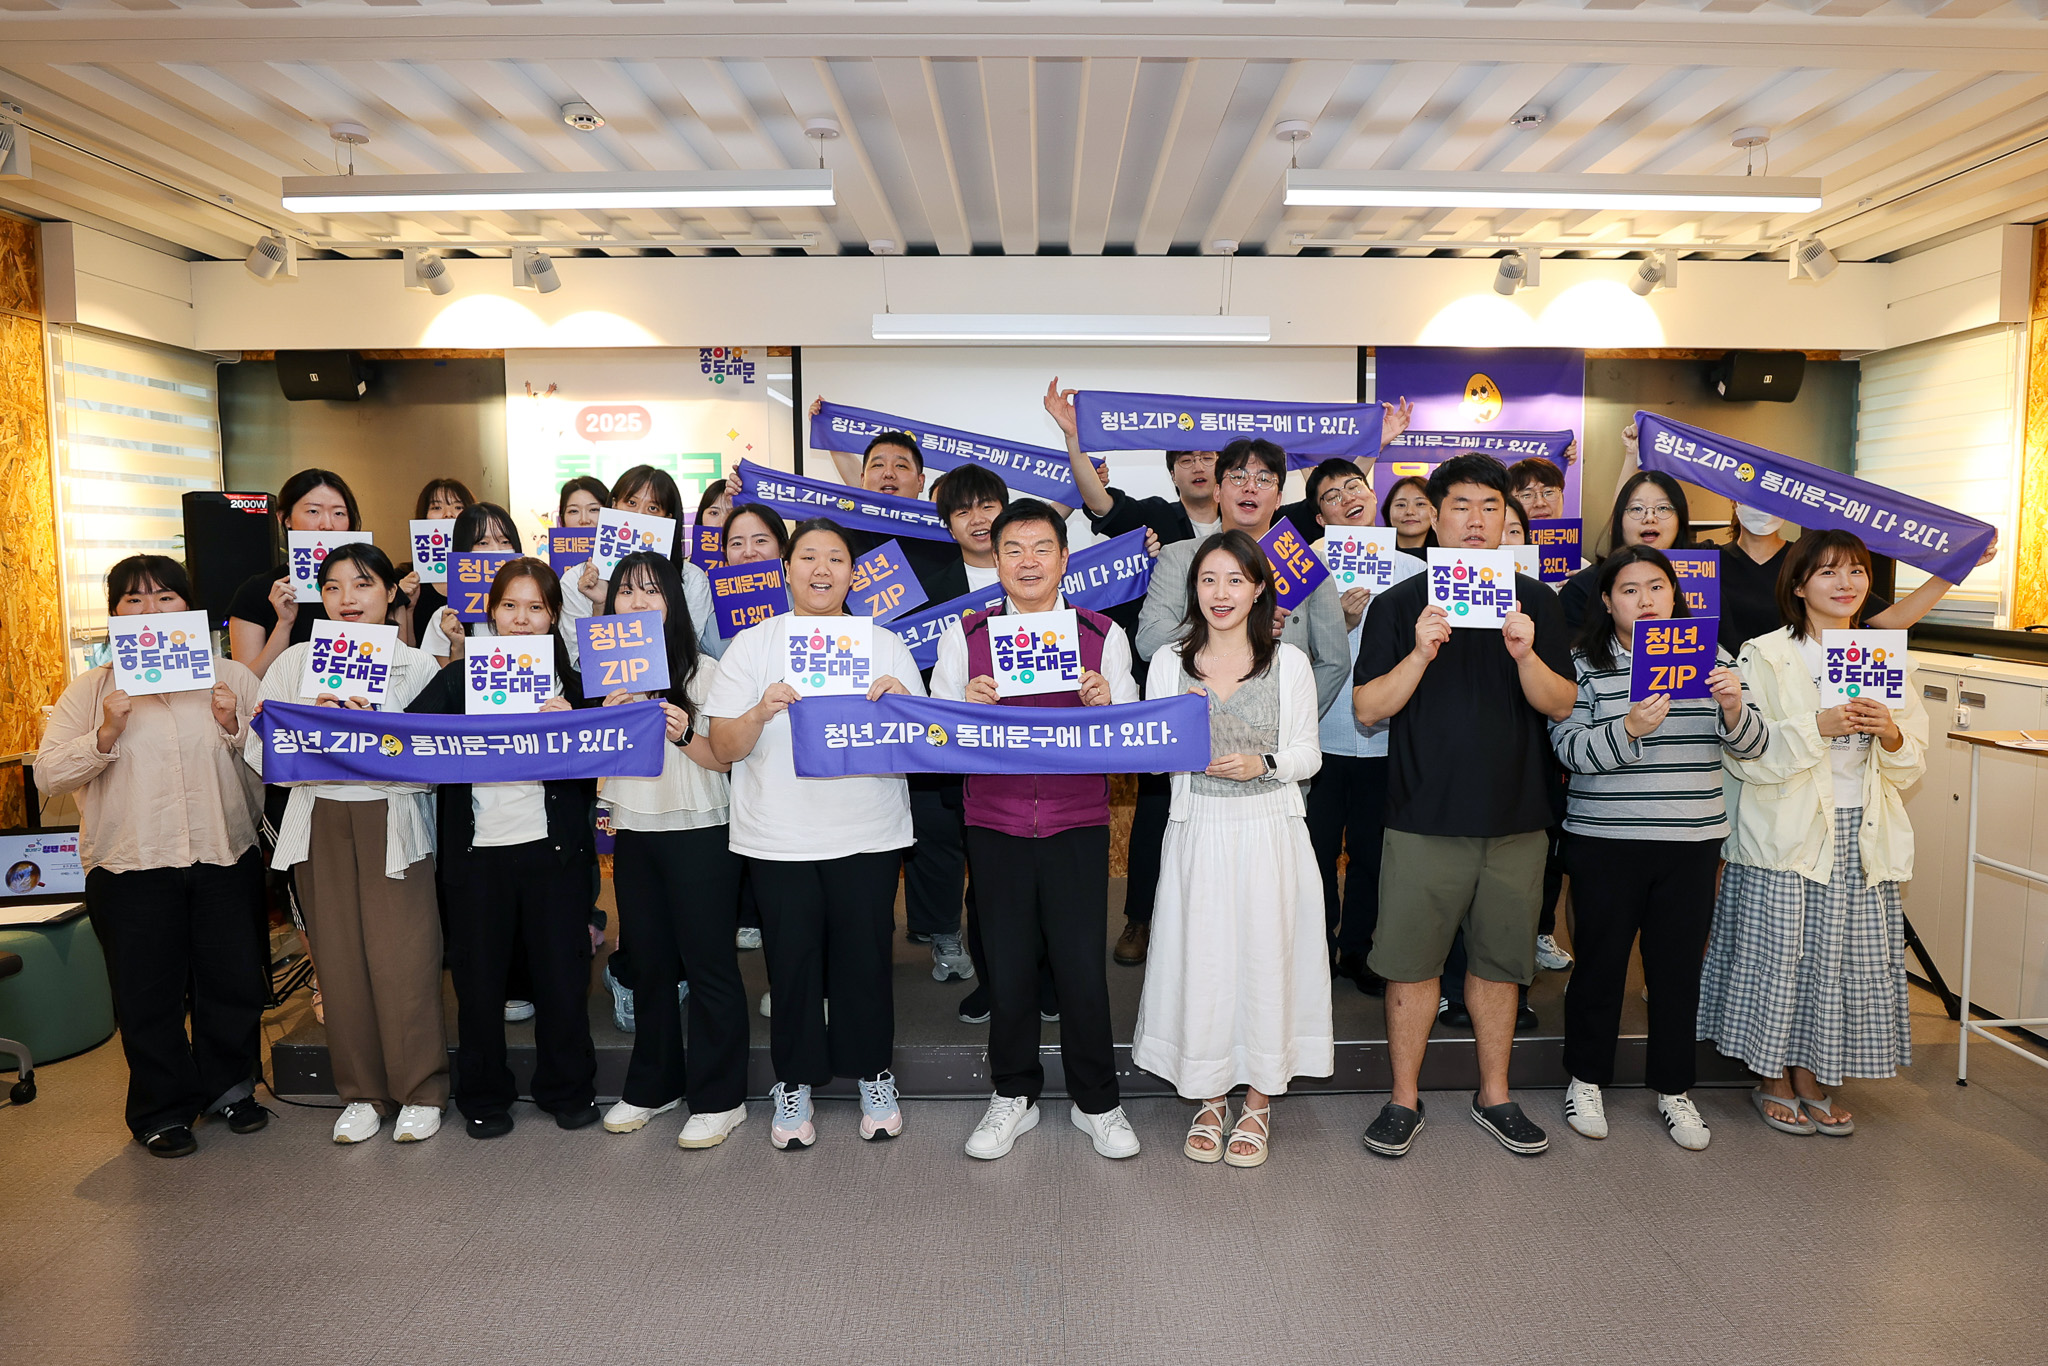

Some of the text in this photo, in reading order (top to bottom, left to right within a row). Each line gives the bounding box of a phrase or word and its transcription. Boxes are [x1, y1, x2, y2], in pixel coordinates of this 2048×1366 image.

[708, 360, 755, 384] 동대문
[585, 412, 643, 433] 2025
[1100, 411, 1360, 435] 청년.ZIP 동대문구에 다 있다.
[921, 433, 1010, 467] 동대문구에
[1011, 453, 1032, 472] 다
[1034, 459, 1073, 485] 있다.
[1484, 437, 1505, 450] 다
[1507, 439, 1550, 456] 있다.
[230, 499, 267, 509] 2000W
[1654, 431, 1949, 553] 청년.ZIP 동대문구에 다 있다.
[1529, 528, 1579, 545] 대문구에
[715, 570, 781, 597] 동대문구에
[1089, 564, 1110, 587] 다
[1336, 556, 1392, 585] 동대문
[465, 593, 489, 613] ZI
[864, 583, 905, 618] ZIP
[1446, 582, 1513, 618] 동대문
[731, 608, 746, 626] 다
[589, 619, 653, 651] 청년.
[1645, 626, 1705, 655] 청년.
[135, 649, 211, 683] 동대문
[319, 656, 388, 693] 동대문
[600, 658, 649, 686] ZIP
[801, 652, 869, 688] 동대문
[1011, 650, 1078, 684] 동대문
[1648, 665, 1697, 691] ZIP
[482, 671, 551, 705] 동대문
[1838, 664, 1903, 698] 동대문
[272, 727, 634, 756] 청년.ZIP 동대문구에 다 있다.
[824, 720, 1179, 749] 청년.ZIP 동대문구에 다 있다.
